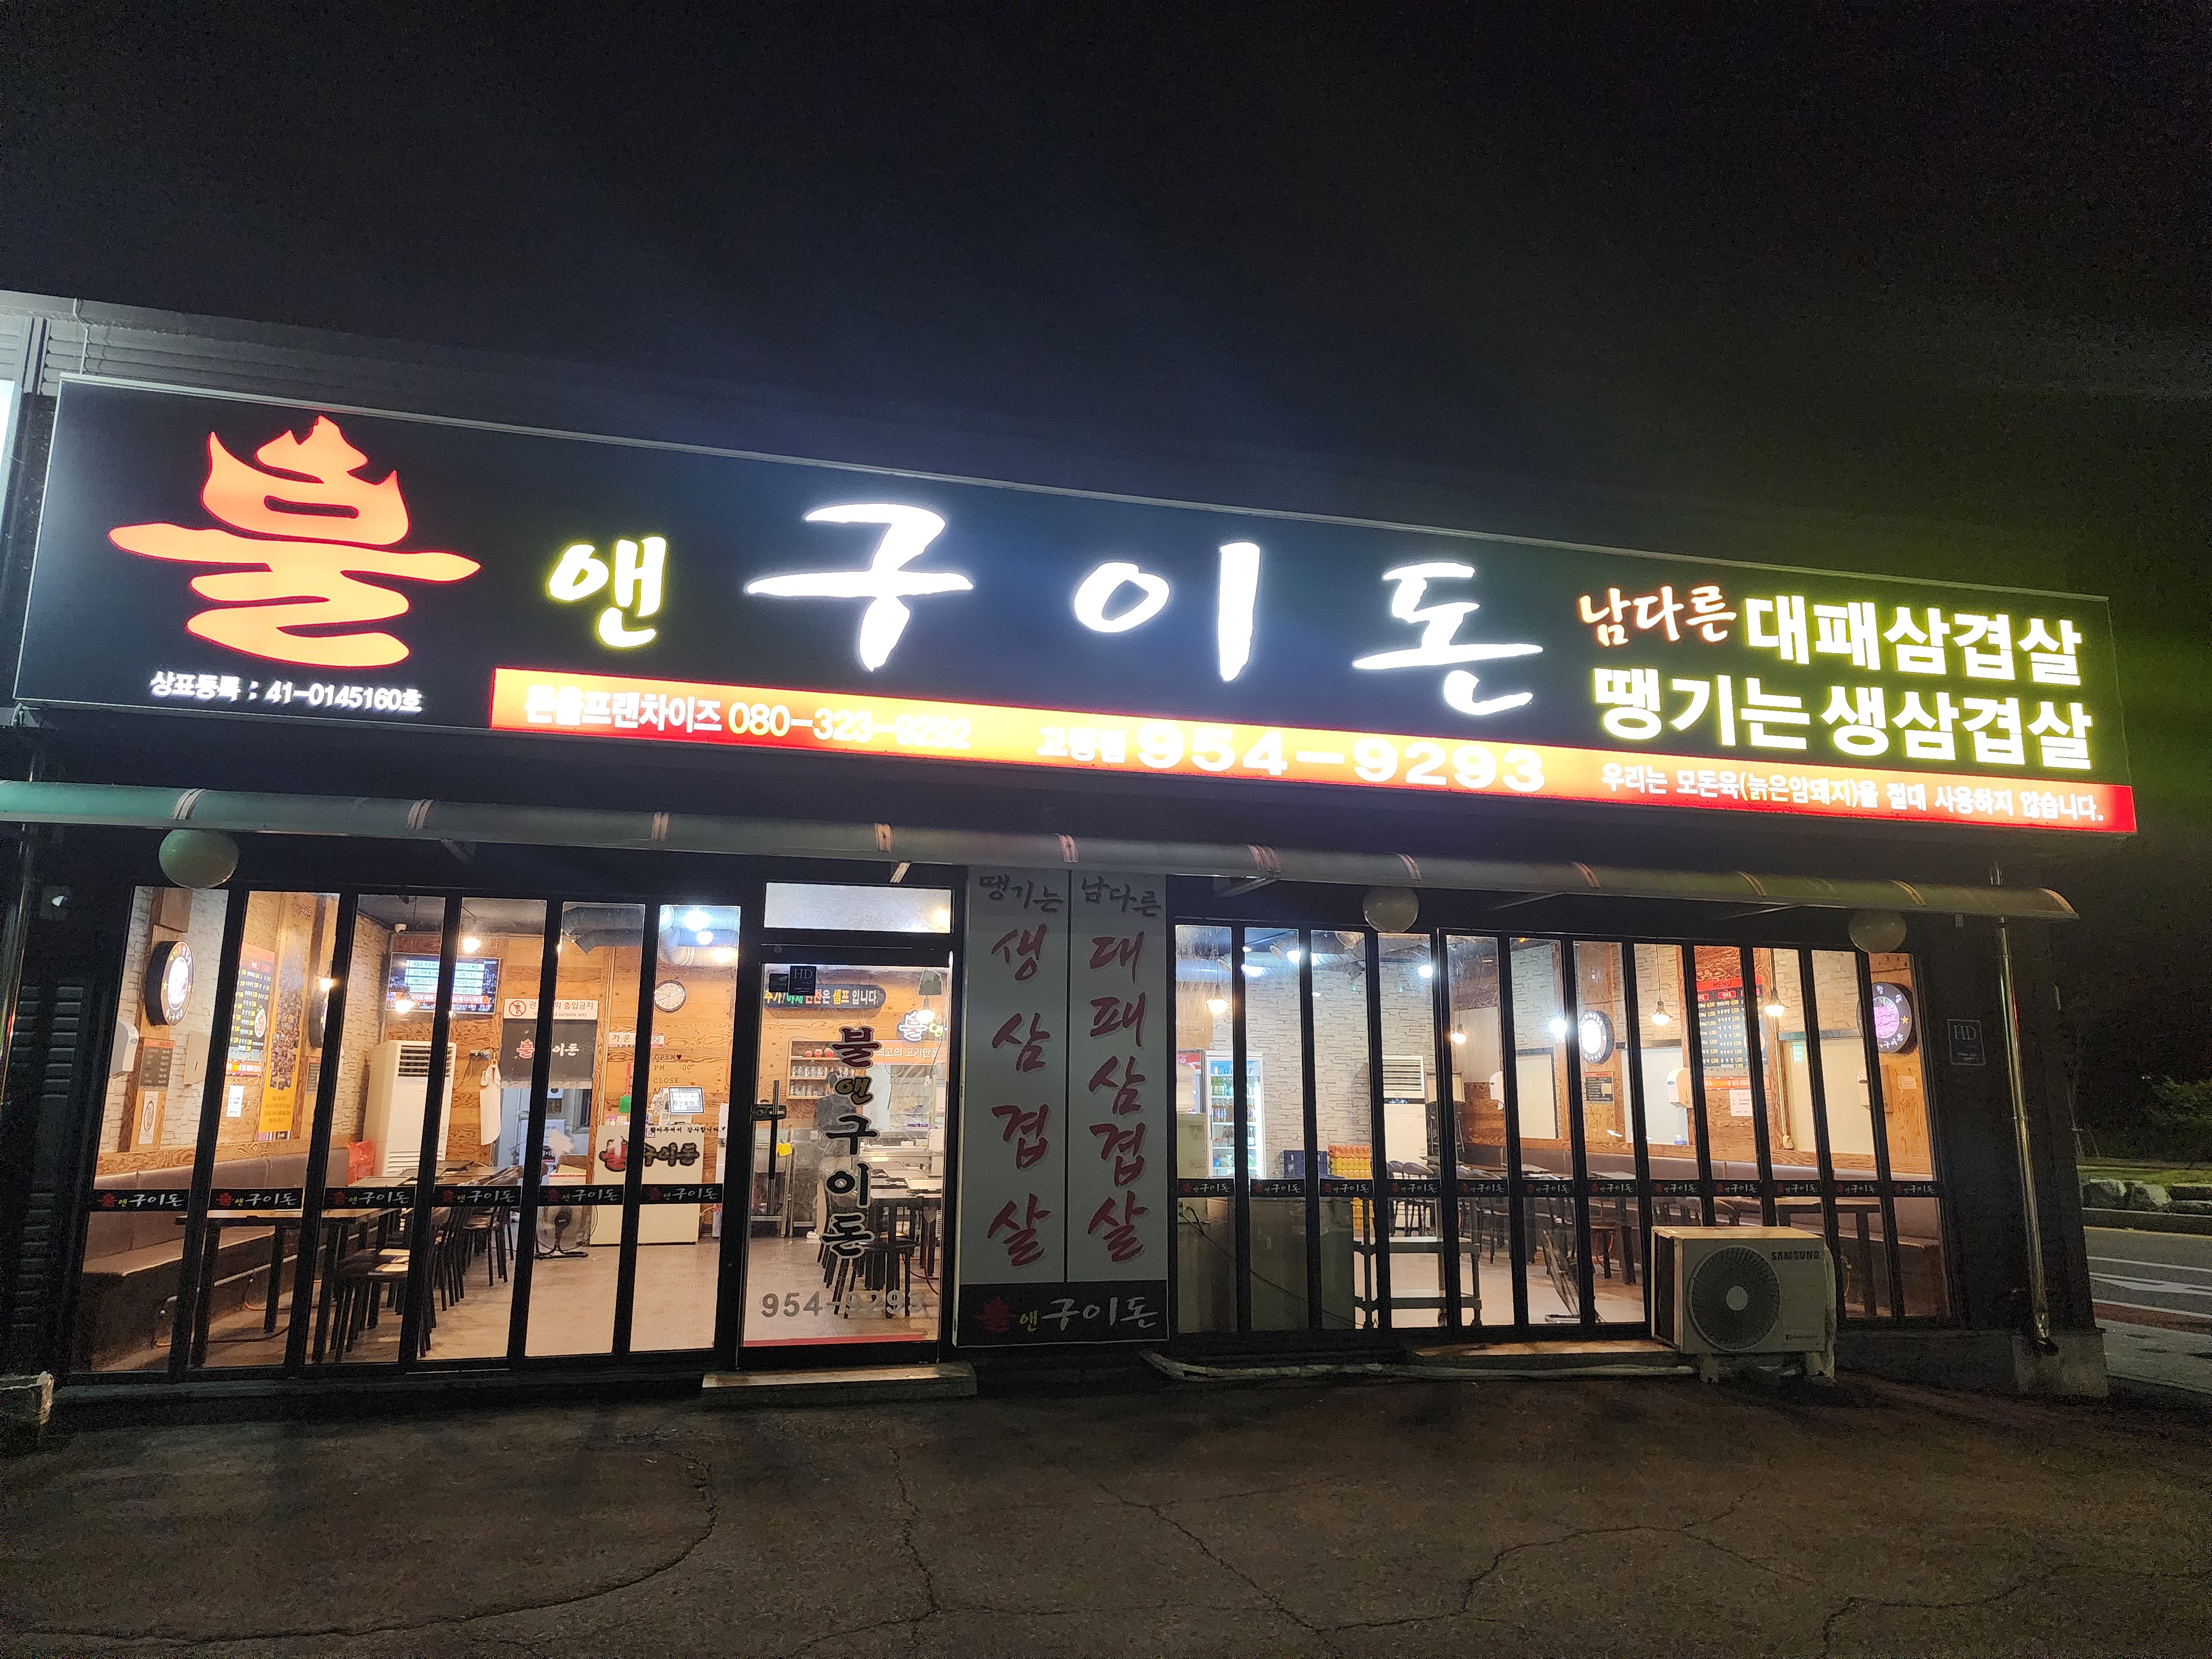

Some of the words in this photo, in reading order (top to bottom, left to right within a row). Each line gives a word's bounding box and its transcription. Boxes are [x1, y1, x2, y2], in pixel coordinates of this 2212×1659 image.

[108, 415, 481, 667] 불
[549, 536, 667, 648] 앤
[747, 503, 1543, 715] 구이돈
[1578, 585, 1736, 648] 남다른
[1744, 595, 2083, 686] 대패삼겹살
[150, 670, 241, 700] 상표등록
[265, 685, 422, 712] 41-0145160호
[728, 702, 972, 750] 080-323-9292
[1593, 667, 1811, 750] 땡기는
[1820, 685, 2092, 770] 생삼겹살
[1137, 722, 1546, 792] 954-9293
[1601, 763, 1667, 792] 우리는
[1886, 781, 1926, 811] 절대
[1934, 787, 2015, 818] 사용하지
[2021, 792, 2104, 822] 않습니다.
[979, 874, 1064, 912] 땡기는
[1082, 875, 1161, 917] 남다른
[1713, 980, 1732, 988] MENU
[564, 1002, 594, 1010] 출입금지
[833, 989, 849, 1005] 셀프
[852, 989, 877, 1005] 입니다
[876, 1047, 902, 1058] 최고의
[129, 1193, 184, 1207] 구이돈
[244, 1192, 297, 1207] 구이돈
[359, 1191, 410, 1204] 구이돈
[468, 1190, 516, 1203] 구이돈
[572, 1188, 620, 1202] 구이돈
[671, 1187, 718, 1201] 구이돈
[1771, 1251, 1820, 1260] SAMSUNG
[761, 1290, 925, 1318] 954-9293
[1041, 1297, 1159, 1331] 구이돈
